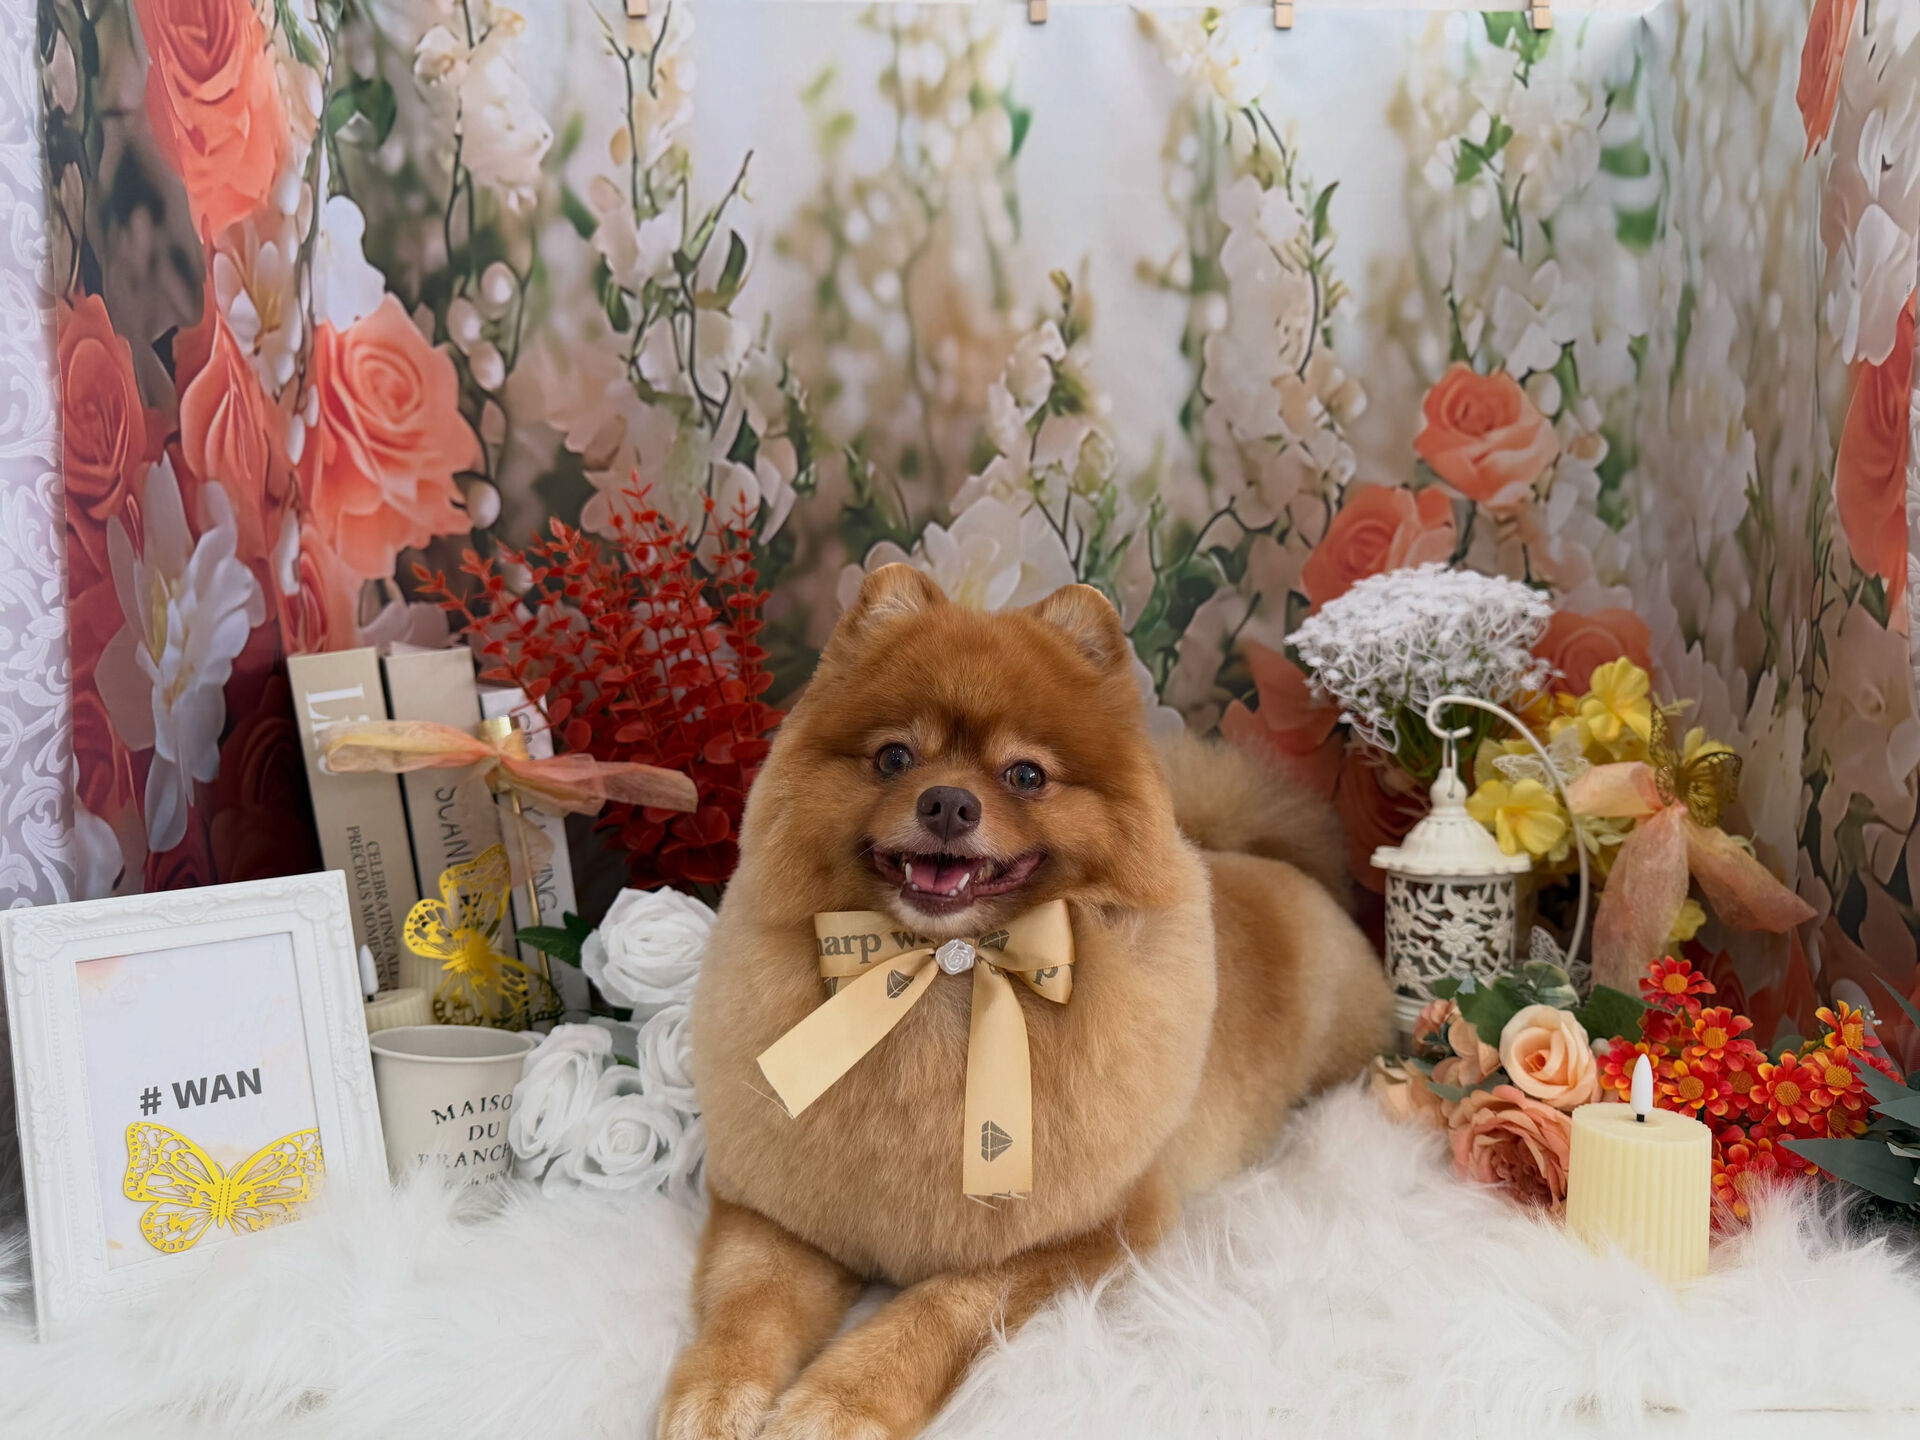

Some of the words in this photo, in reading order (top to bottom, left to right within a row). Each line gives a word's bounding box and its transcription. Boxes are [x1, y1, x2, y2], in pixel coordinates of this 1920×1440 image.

[346, 826, 373, 900] PRECIOUS
[361, 903, 386, 979] MOMENTS
[366, 841, 398, 949] CELEBRATING
[385, 951, 400, 981] ALL
[171, 1067, 263, 1110] WAN
[431, 1094, 513, 1125] MAISO
[469, 1121, 501, 1141] DU
